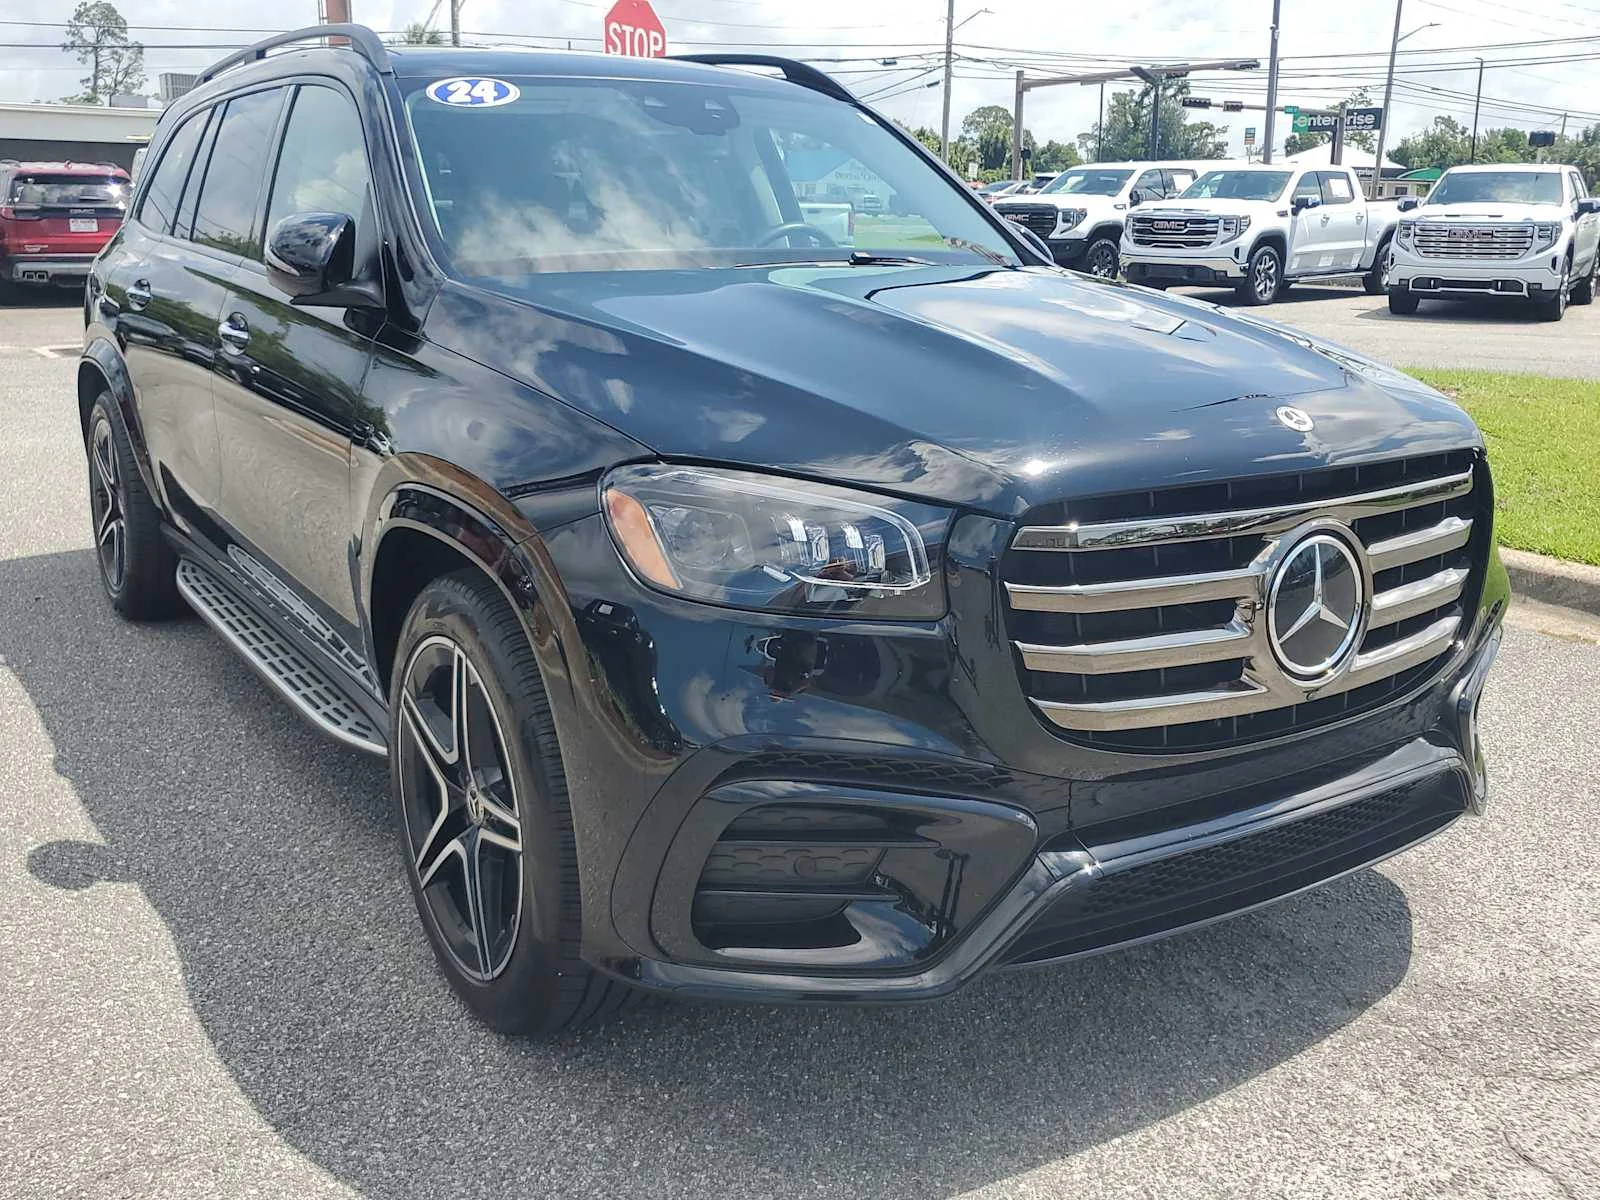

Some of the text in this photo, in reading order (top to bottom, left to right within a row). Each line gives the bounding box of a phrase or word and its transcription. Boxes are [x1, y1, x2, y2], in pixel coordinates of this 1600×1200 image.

[608, 22, 662, 57] STOP
[447, 80, 498, 104] 24
[1296, 112, 1375, 127] enterrise
[1153, 220, 1185, 229] GMC
